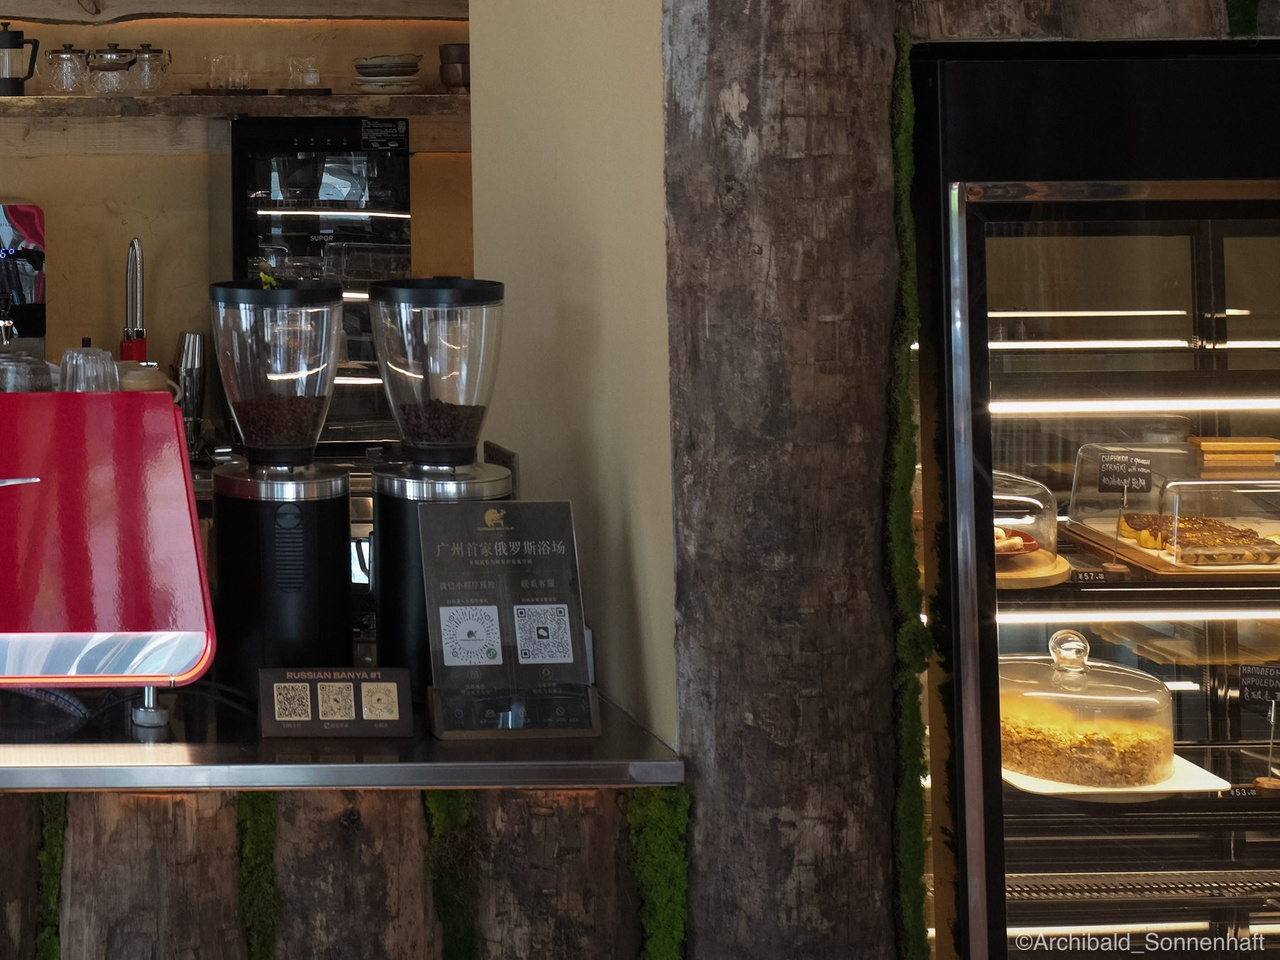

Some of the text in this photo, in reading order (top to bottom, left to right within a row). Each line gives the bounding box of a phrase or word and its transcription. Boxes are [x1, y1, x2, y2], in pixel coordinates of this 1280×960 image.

[436, 540, 566, 558] 广州首家俄罗斯浴场
[286, 671, 382, 680] RUSSIAN BANYA #1
